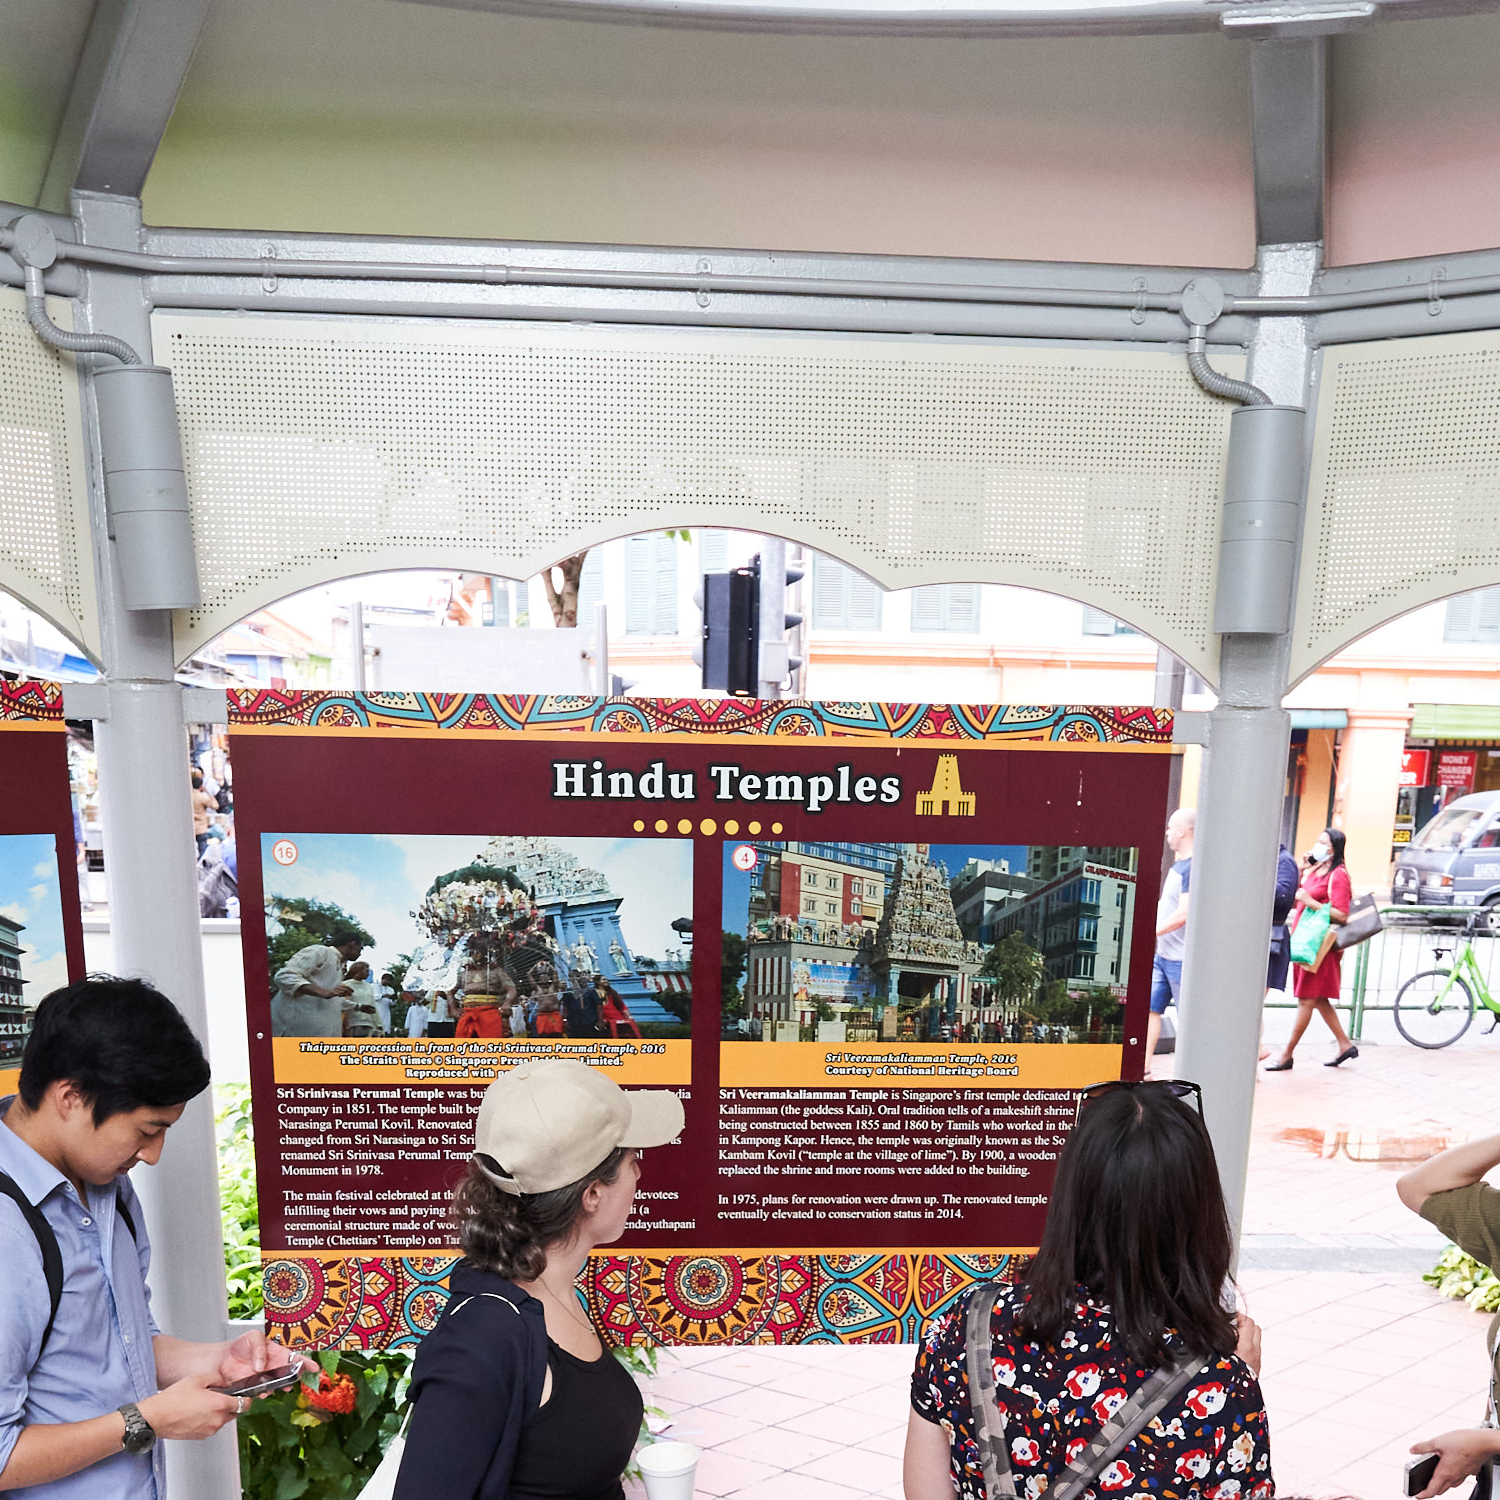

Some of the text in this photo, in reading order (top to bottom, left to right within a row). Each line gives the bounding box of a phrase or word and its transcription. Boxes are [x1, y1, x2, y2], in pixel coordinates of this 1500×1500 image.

[553, 760, 900, 812] Hindu Temples
[278, 846, 294, 859] 16
[741, 852, 749, 864] 4
[299, 1042, 665, 1056] Thaipusam procession in front of the Sri Srinivasa Perumal Temple, 2016
[339, 1055, 361, 1065] The
[362, 1054, 400, 1065] Straits
[400, 1054, 433, 1065] Times
[445, 1054, 498, 1068] Singapore
[500, 1055, 528, 1065] Press
[825, 1053, 1017, 1065] Sri Veeramakaliamman Temple, 2016
[406, 1067, 497, 1080] Reproduced with
[825, 1065, 1019, 1078] Courtesy of National Heritage Board
[718, 1193, 1048, 1207] In 1975, plans for renovation were drawn up. The renovated temple
[717, 1208, 964, 1222] eventually elevated to conservation status in 2014.
